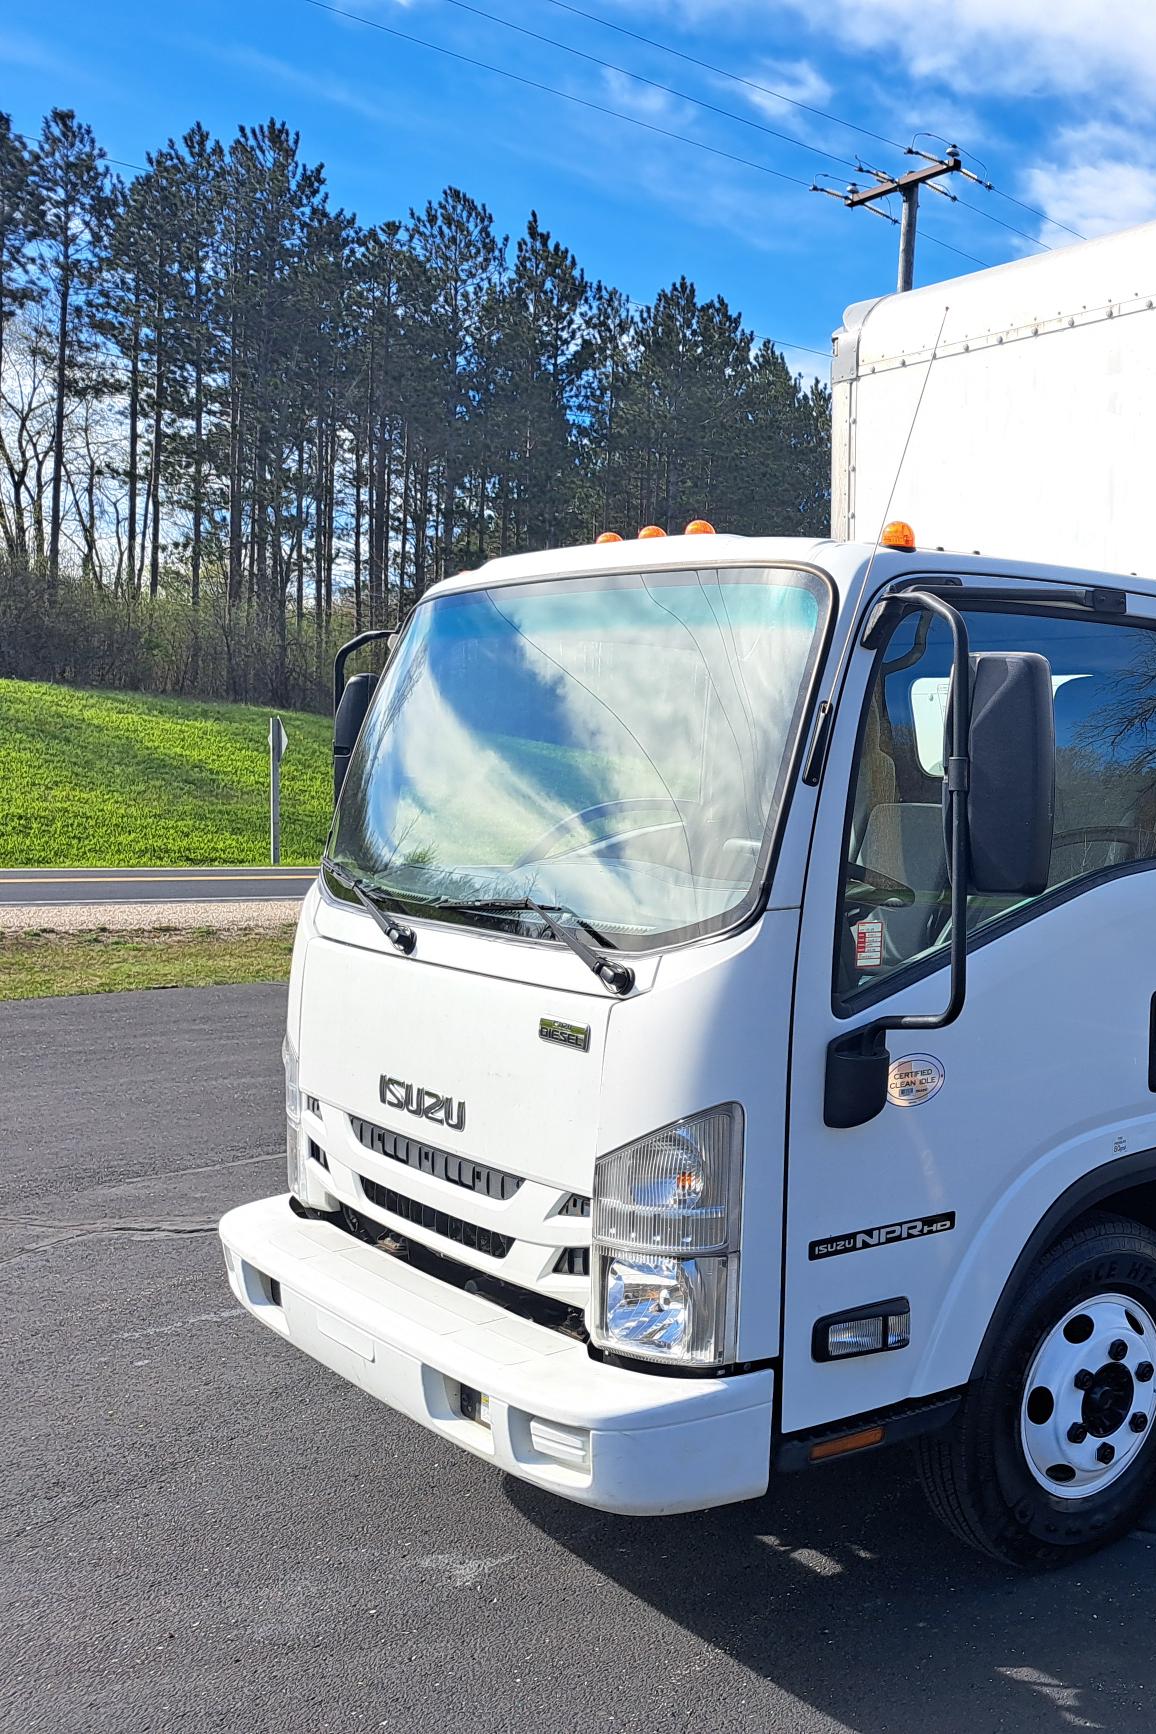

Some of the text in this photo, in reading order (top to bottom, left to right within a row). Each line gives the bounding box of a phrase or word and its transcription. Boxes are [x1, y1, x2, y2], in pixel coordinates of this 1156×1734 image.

[540, 1027, 583, 1047] DIESEL
[894, 1068, 933, 1080] CERTIFIED
[889, 1076, 936, 1090] CLEAN IDLE
[379, 1072, 466, 1133] ISUZU
[814, 1238, 854, 1255] ISUZU
